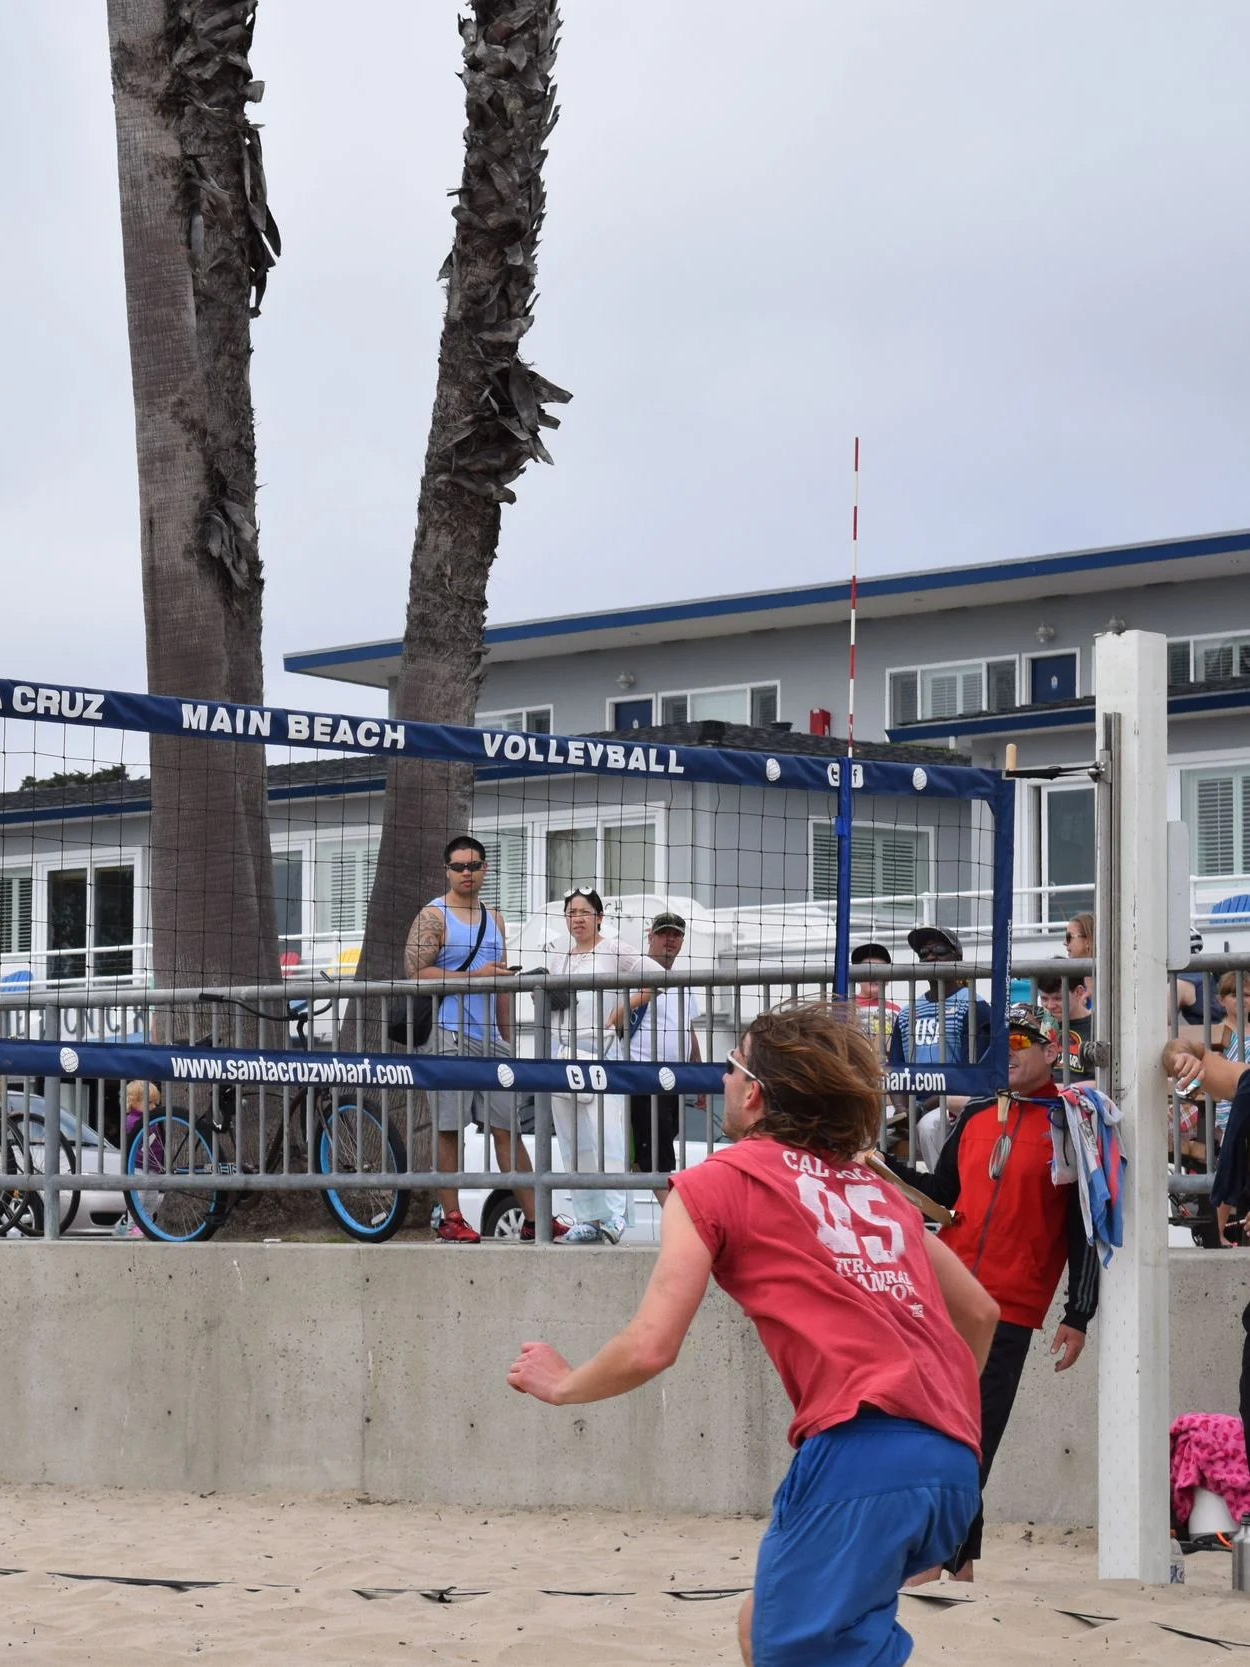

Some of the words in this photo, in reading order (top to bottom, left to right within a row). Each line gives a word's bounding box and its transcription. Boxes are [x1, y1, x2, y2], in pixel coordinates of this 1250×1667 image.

[12, 685, 105, 720] CRUZ
[181, 703, 272, 737] MAIN
[287, 714, 406, 750] BEACH
[482, 732, 685, 774] VOLLEYBALL
[170, 1056, 414, 1085] www.santacruzwharf.com
[782, 1150, 830, 1178] CAL
